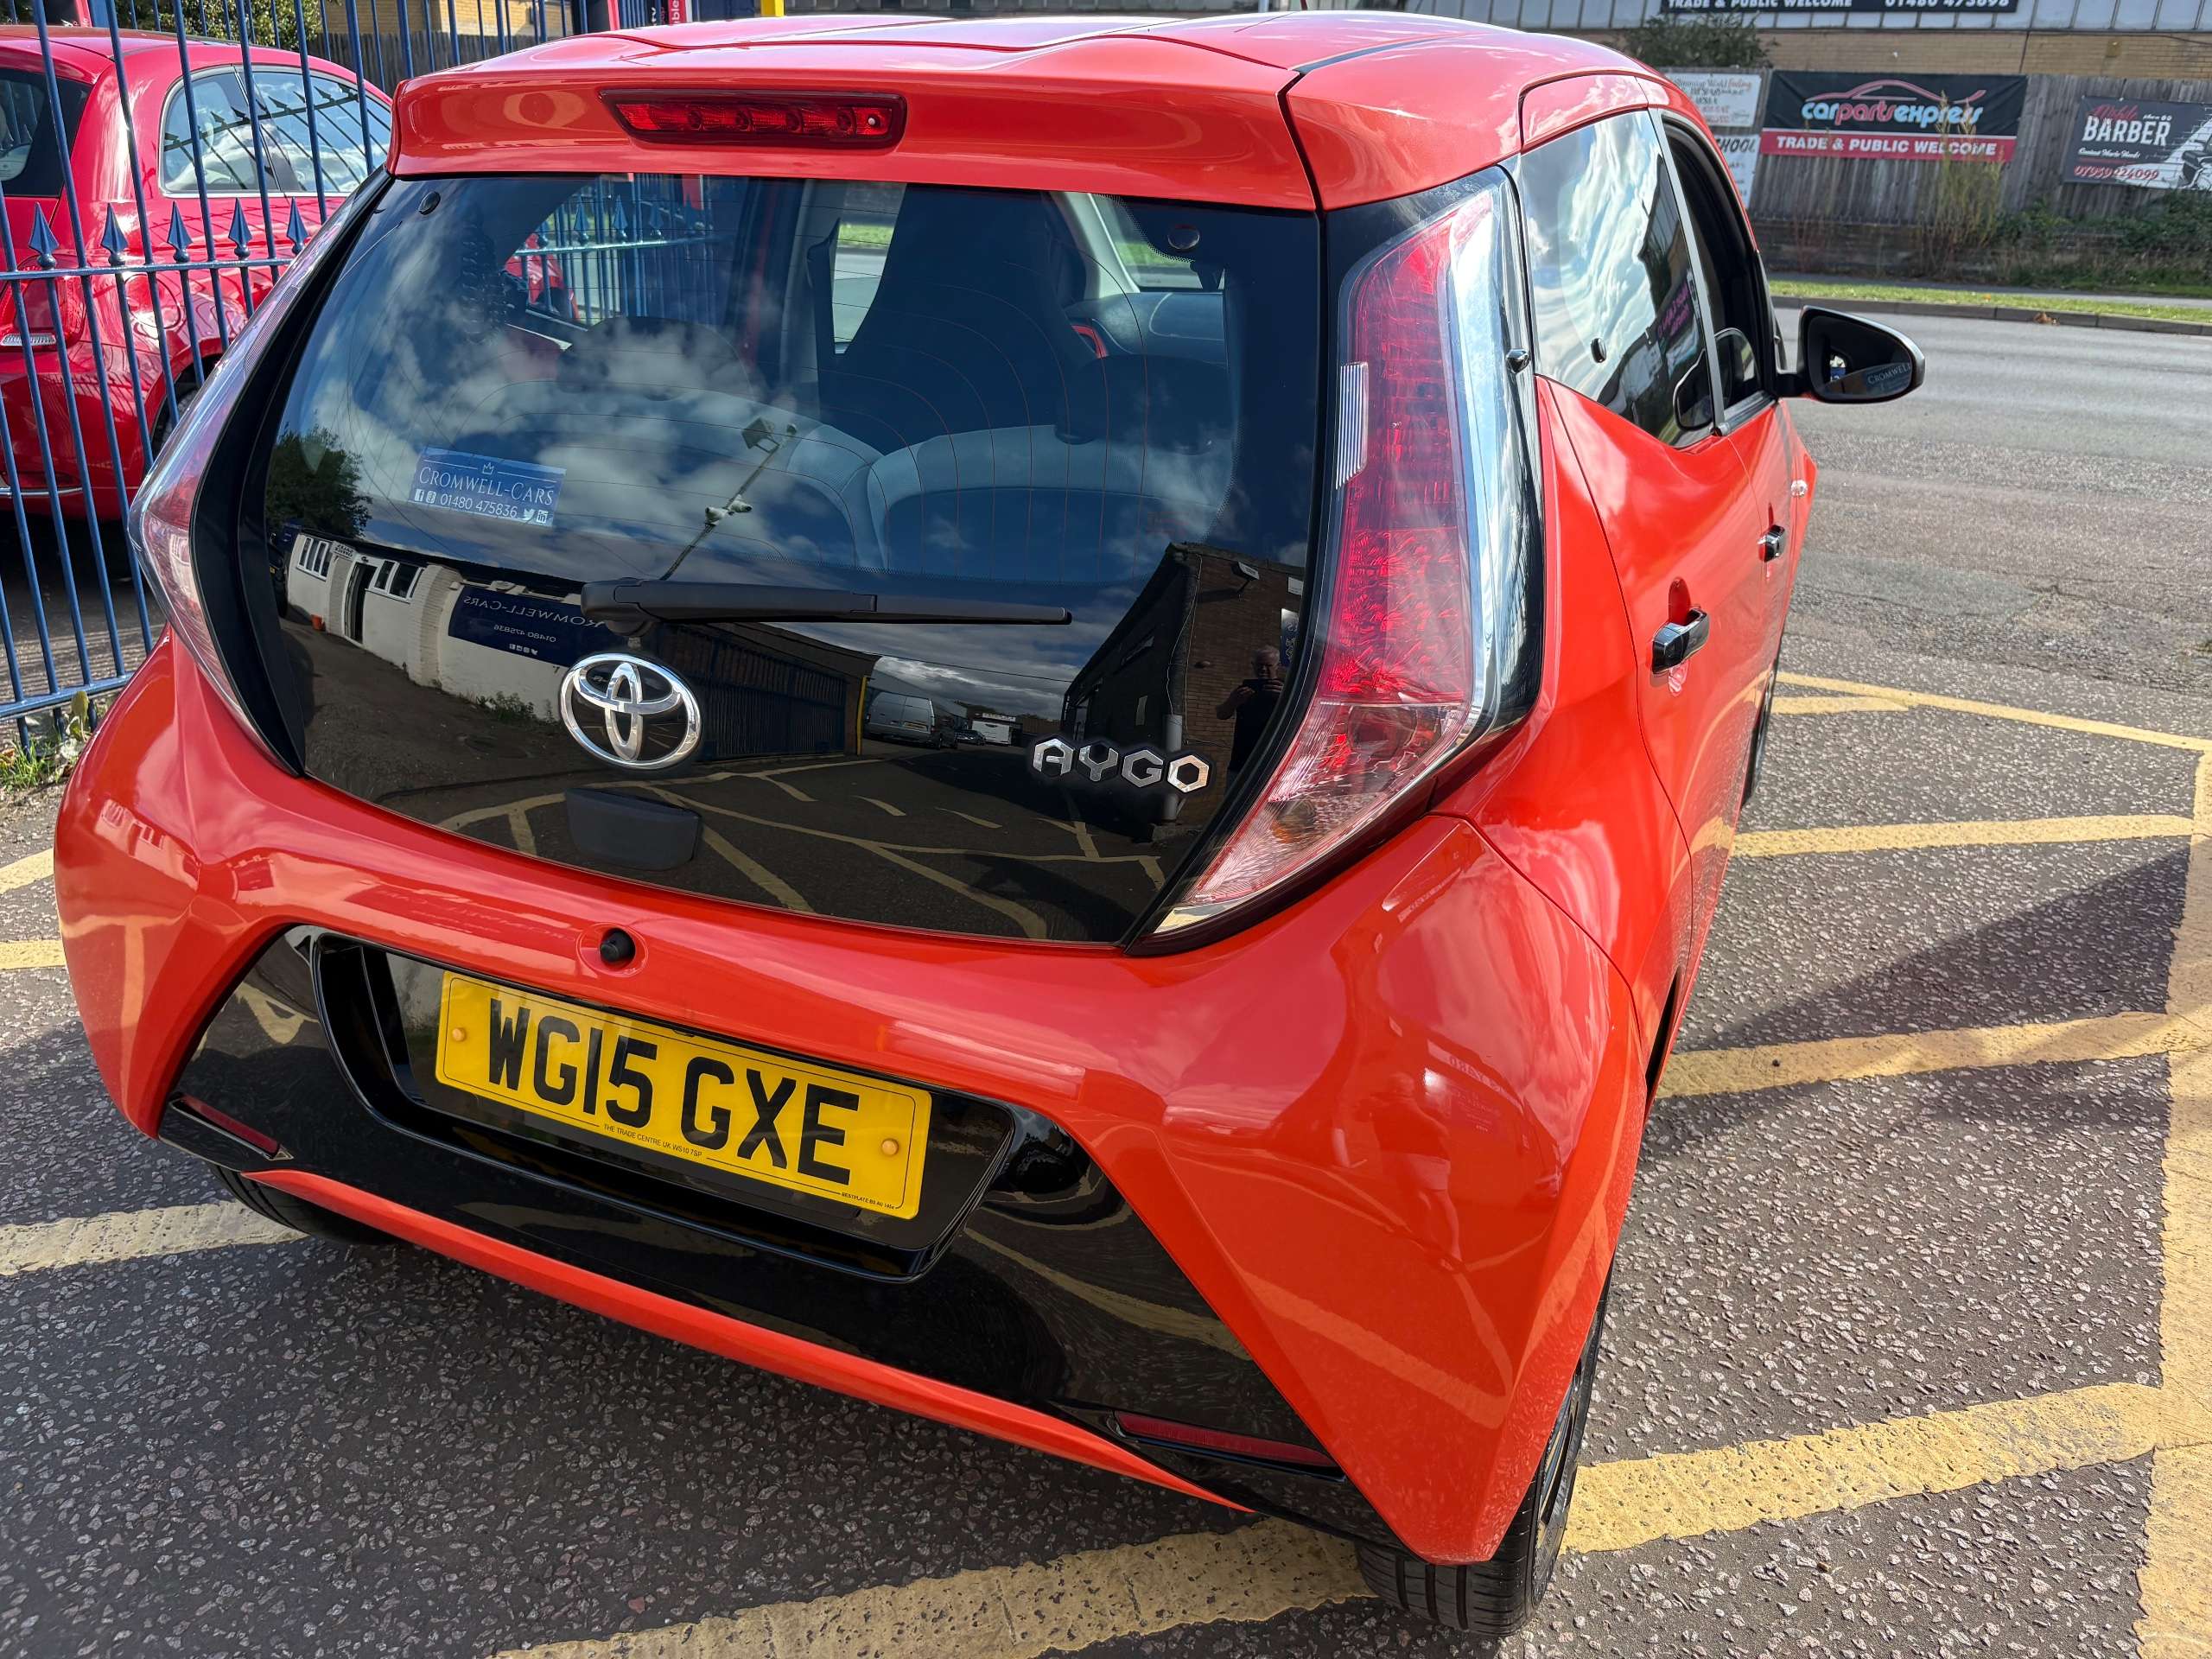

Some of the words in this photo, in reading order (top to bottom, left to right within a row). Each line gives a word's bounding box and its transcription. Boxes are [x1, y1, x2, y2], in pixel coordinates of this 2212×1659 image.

[2082, 115, 2171, 147] BARBER
[1777, 136, 1827, 150] TRADE
[1832, 138, 1844, 151] &
[1848, 139, 1910, 154] PUBLIC
[1914, 141, 1998, 156] WELCOME
[440, 493, 474, 510] 01480
[475, 500, 518, 518] 475836
[1033, 738, 1210, 793] AYGO
[488, 997, 658, 1128] WG15
[681, 1056, 860, 1185] GXE
[604, 1123, 615, 1133] THE
[617, 1127, 637, 1138] TRADE
[637, 1133, 662, 1147] CENTRE
[662, 1141, 672, 1150] UK
